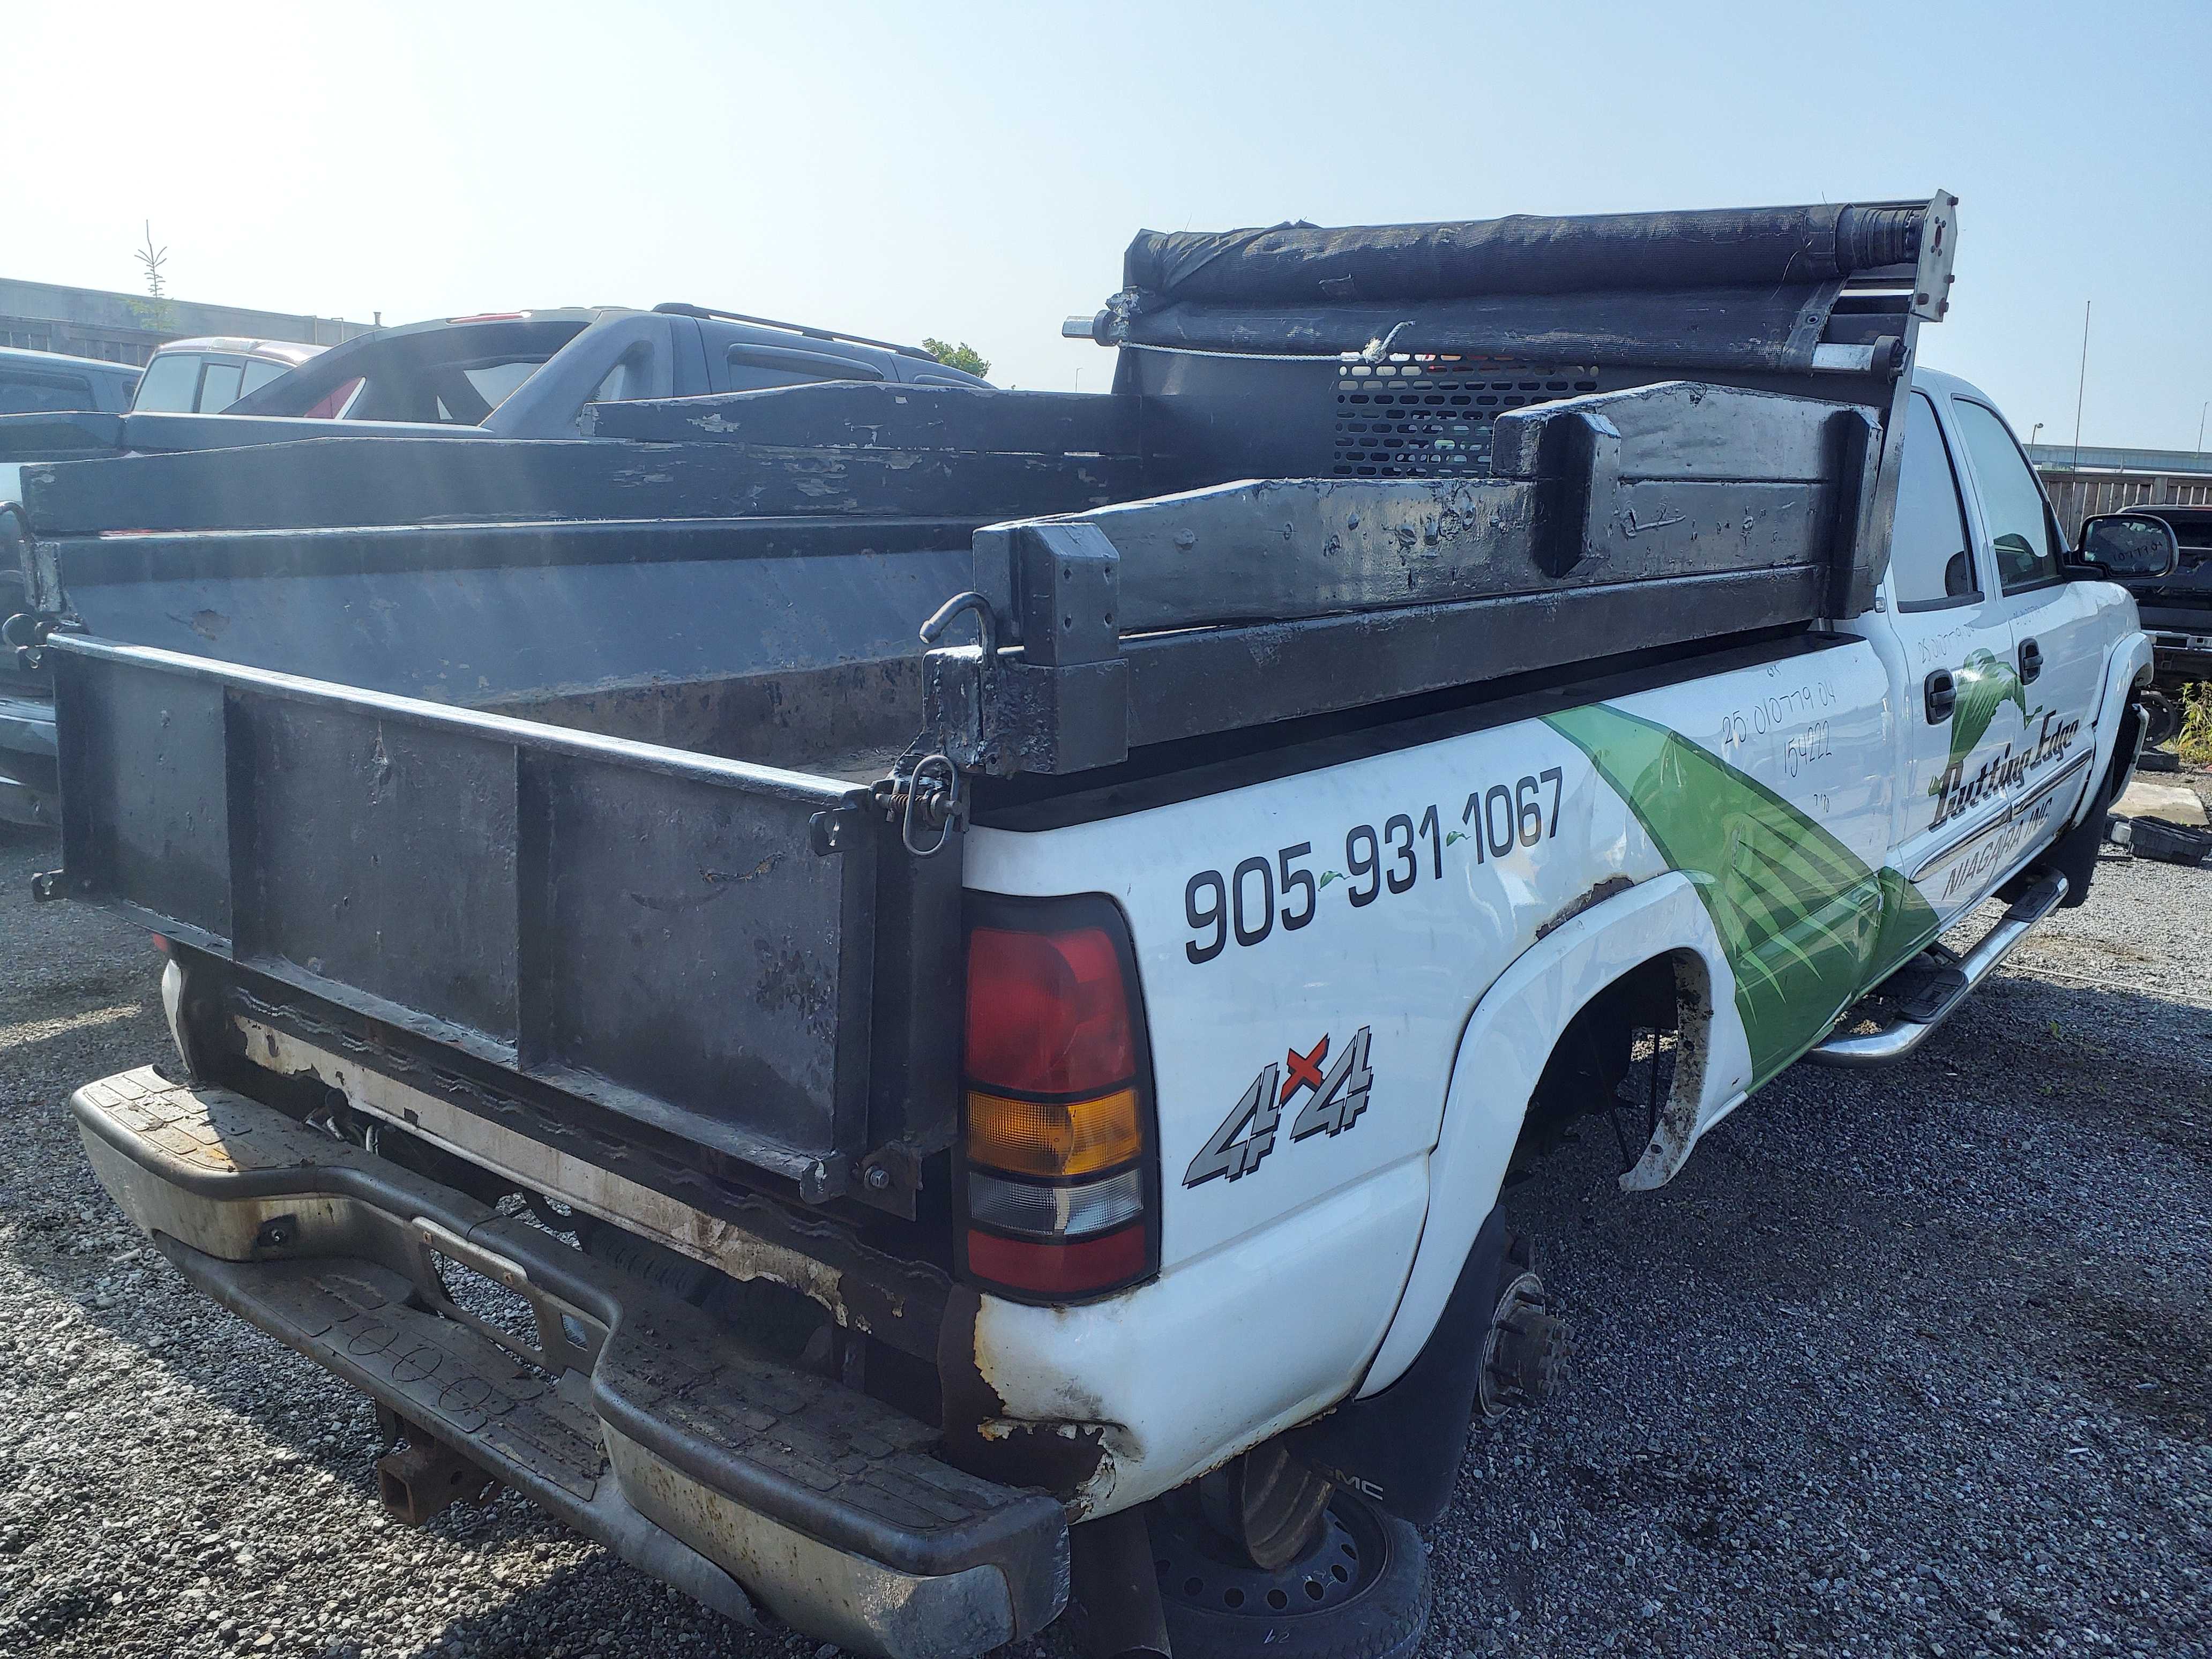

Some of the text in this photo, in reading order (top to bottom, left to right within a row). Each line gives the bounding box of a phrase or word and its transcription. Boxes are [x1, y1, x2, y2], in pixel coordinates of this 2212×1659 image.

[2029, 708, 2079, 771] Edge
[1941, 797, 2053, 901] NIAGARA INC
